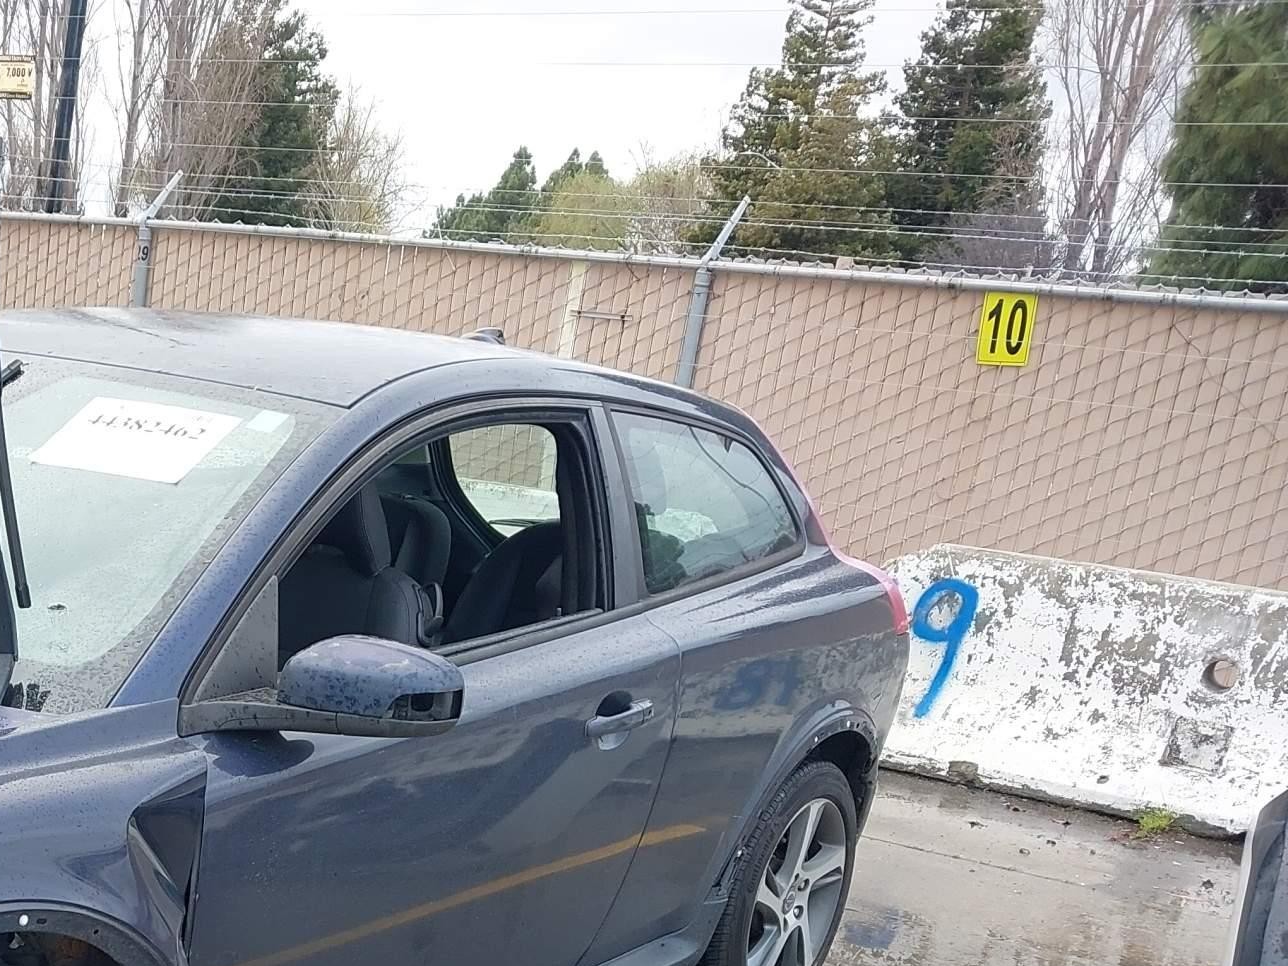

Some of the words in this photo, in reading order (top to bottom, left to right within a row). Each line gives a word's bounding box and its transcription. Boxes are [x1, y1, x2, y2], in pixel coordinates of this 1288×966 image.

[6, 67, 26, 78] 7,000
[988, 299, 1028, 356] 10
[88, 414, 207, 440] 44382462
[913, 578, 979, 719] 9
